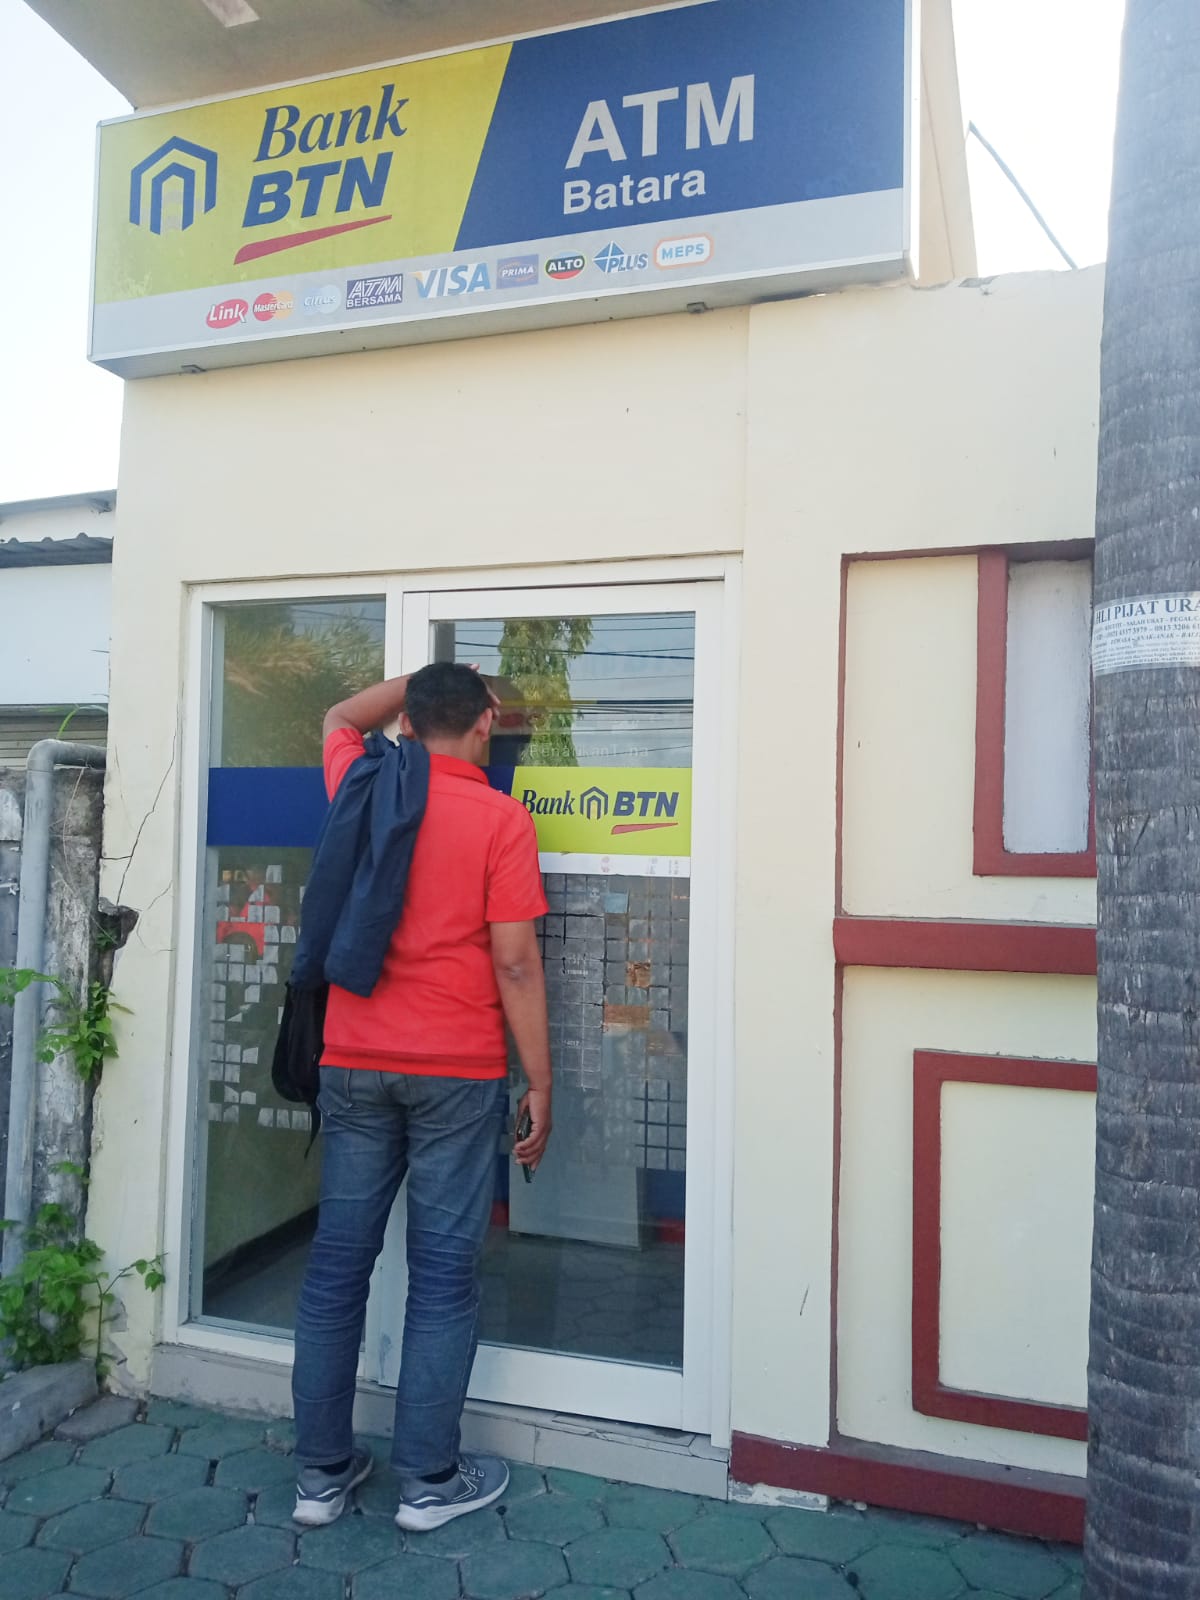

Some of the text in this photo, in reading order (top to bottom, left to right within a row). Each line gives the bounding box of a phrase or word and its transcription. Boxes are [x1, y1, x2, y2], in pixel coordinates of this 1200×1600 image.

[253, 84, 410, 163] Bank
[565, 74, 755, 170] ATM
[241, 151, 394, 228] BTN
[563, 168, 706, 215] Batara
[661, 243, 704, 260] MEPS
[502, 266, 534, 278] PRIMA
[548, 257, 583, 272] ALTO
[607, 252, 649, 273] PLUS
[348, 276, 402, 299] ATM
[413, 263, 491, 298] VISA
[253, 299, 295, 313] MasterCard
[347, 293, 402, 308] BERSAMA
[209, 303, 247, 323] Link
[1114, 600, 1159, 620] PIJAT
[522, 789, 679, 817] Bank BTN
